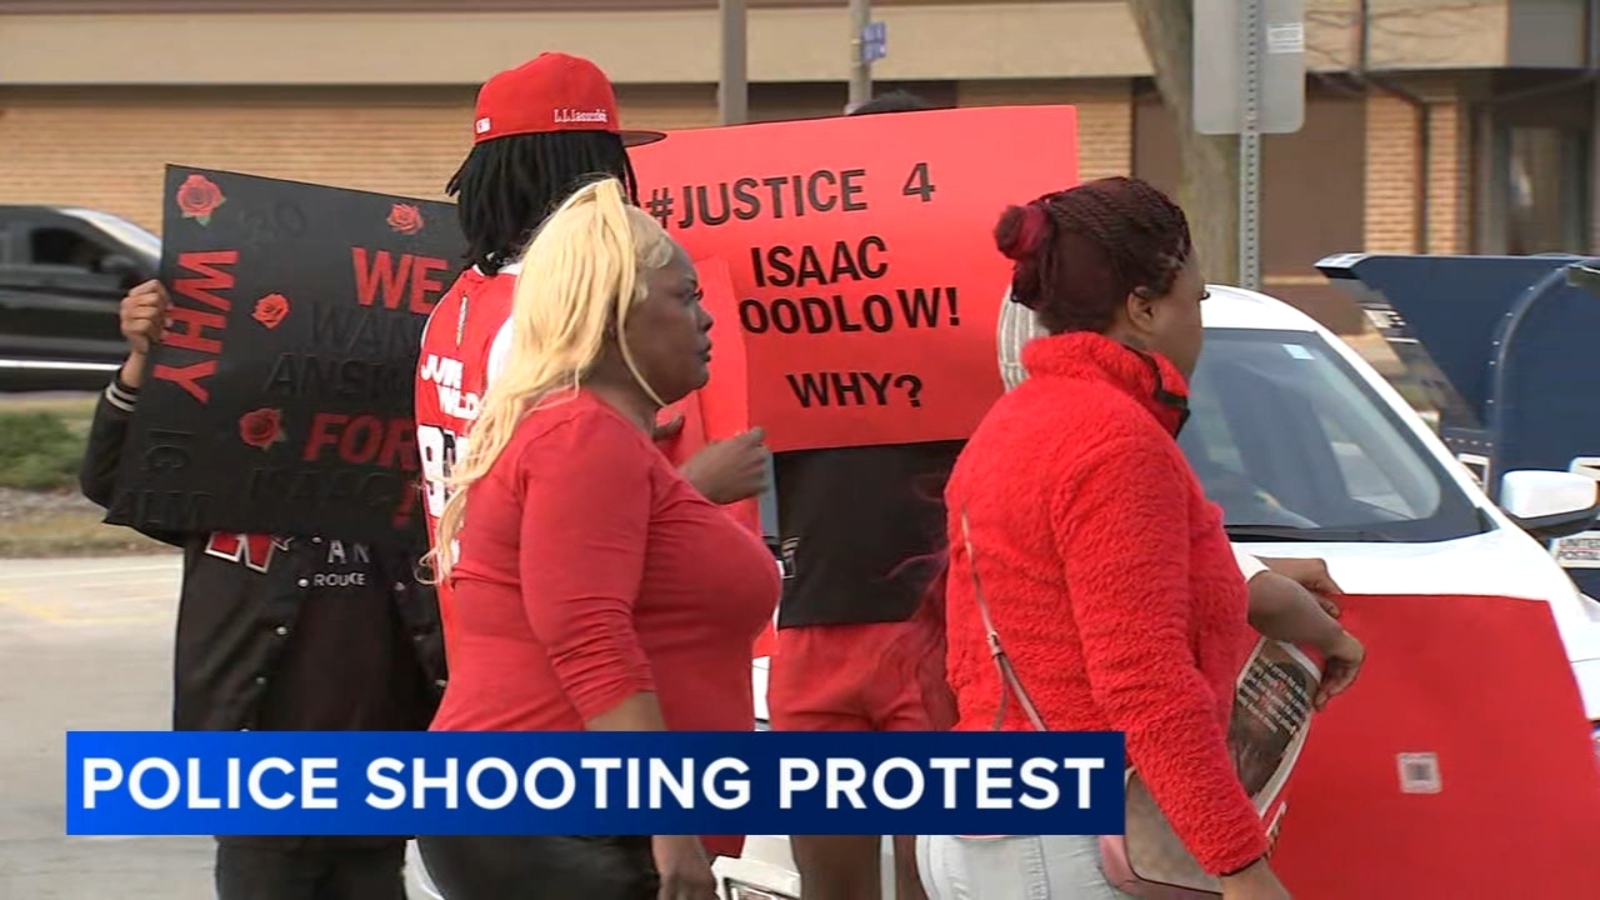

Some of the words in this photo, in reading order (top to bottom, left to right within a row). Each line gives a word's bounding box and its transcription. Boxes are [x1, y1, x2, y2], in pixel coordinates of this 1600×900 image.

[646, 168, 867, 229] #JUSTICE
[902, 162, 936, 202] 4
[351, 246, 449, 315] WE
[750, 235, 888, 287] ISAAC
[152, 248, 240, 405] WHY
[786, 372, 923, 408] WHY?
[300, 410, 418, 470] FOR
